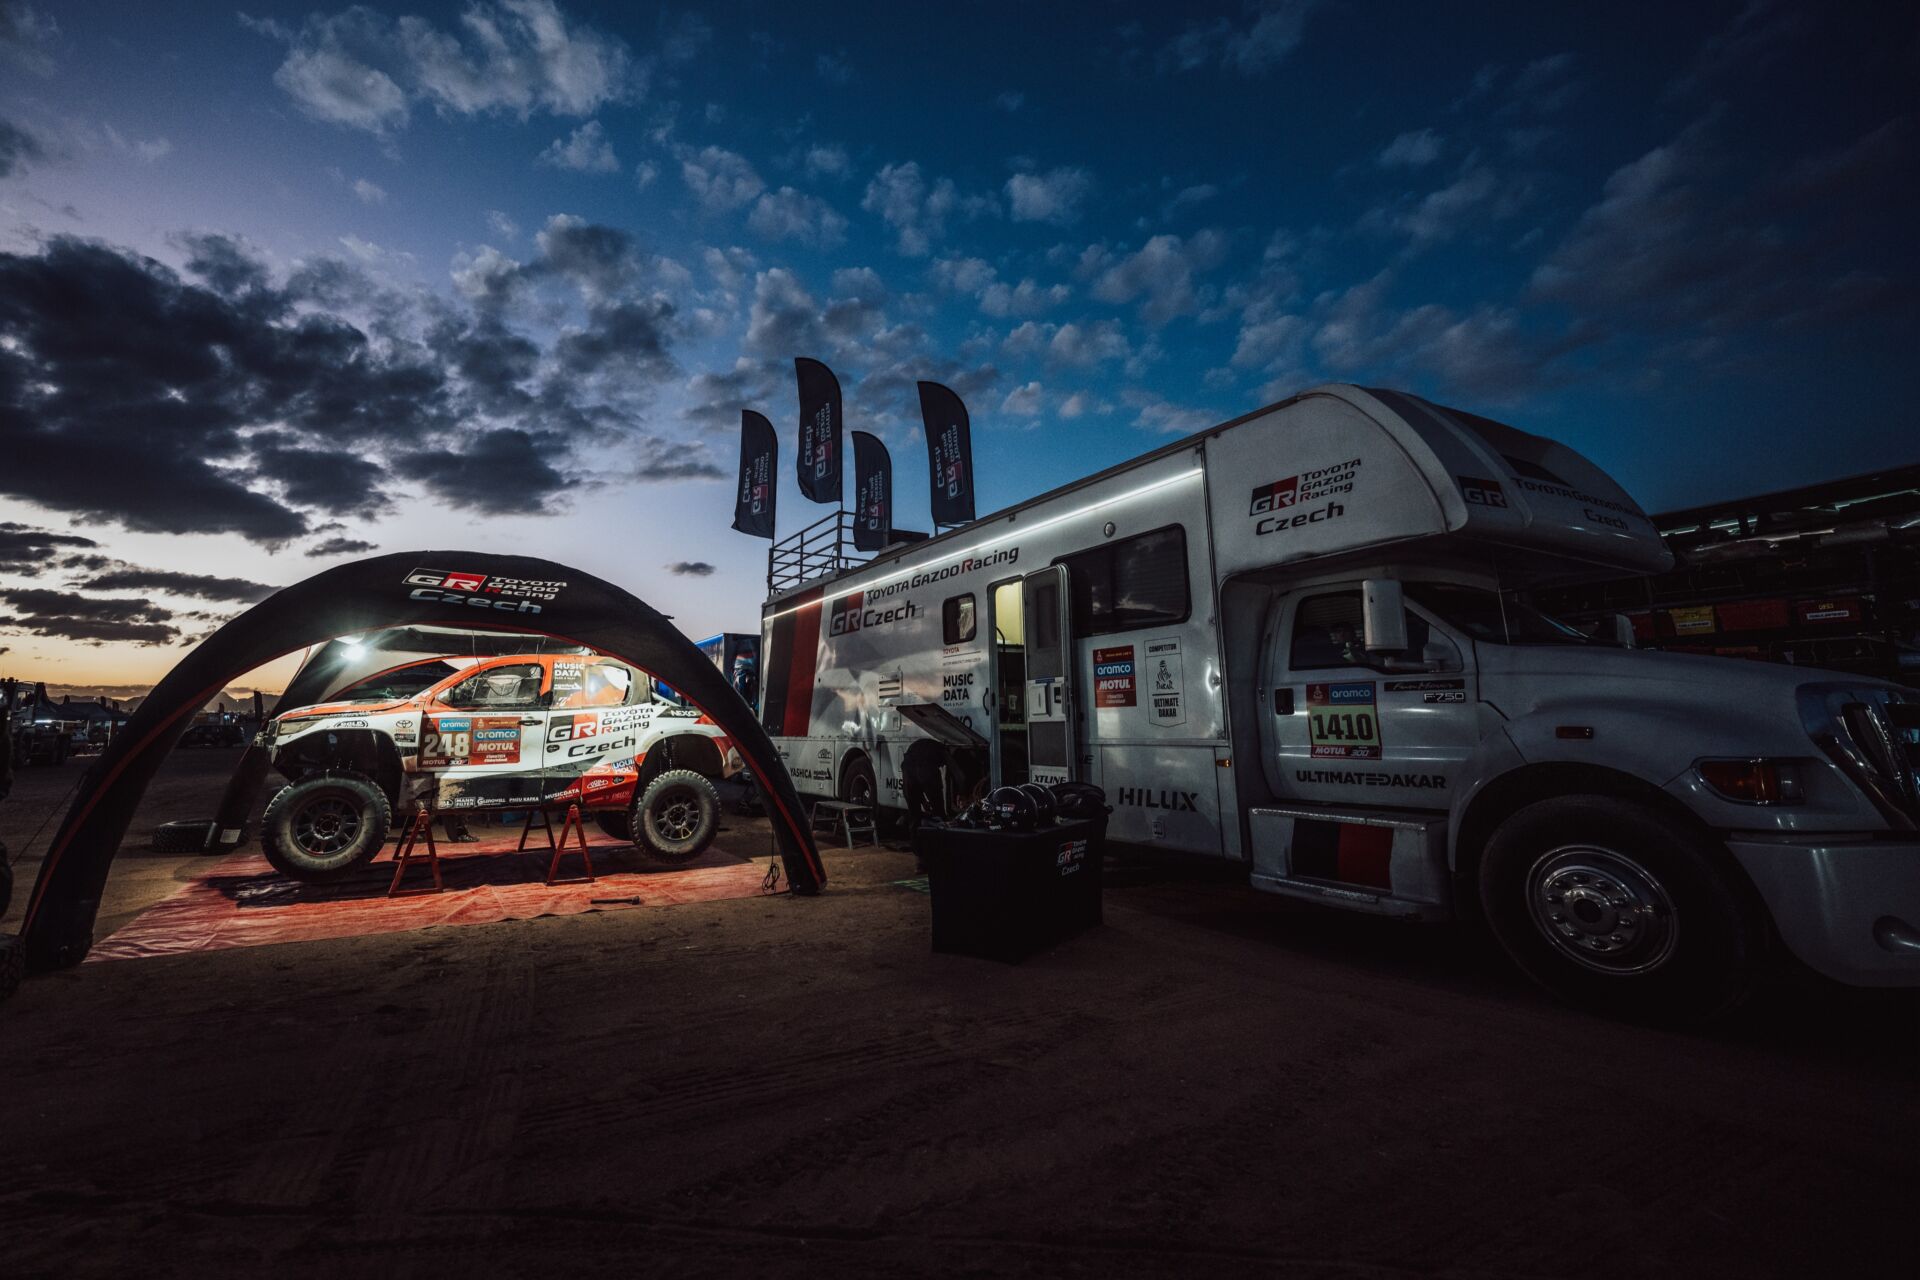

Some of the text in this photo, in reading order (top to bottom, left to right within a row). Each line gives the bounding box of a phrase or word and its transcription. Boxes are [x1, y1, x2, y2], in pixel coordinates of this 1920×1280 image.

[1301, 458, 1362, 482] TOYOTA
[1300, 471, 1356, 492] GAZOO
[1299, 482, 1354, 503] Racing
[1251, 489, 1295, 515] GR
[1256, 502, 1345, 536] Czech
[1583, 509, 1629, 531] Czech
[866, 547, 1020, 602] TOYOTA GAZOO Racing
[408, 574, 479, 592] GR
[487, 582, 560, 593] GAZOO
[491, 576, 568, 588] TOYOTA
[409, 588, 543, 614] Czech
[863, 600, 916, 627] Czech
[831, 607, 862, 636] GR
[1148, 643, 1177, 653] COMPETITOR
[1097, 664, 1131, 676] aramco
[943, 673, 974, 688] MUSIC
[1099, 678, 1131, 690] MOTUL
[943, 688, 970, 701] DATA
[1331, 689, 1371, 698] aramco
[1153, 697, 1179, 708] ULTIMATE
[603, 707, 654, 718] TOYOTA
[1158, 707, 1177, 718] DAKAR
[601, 714, 650, 726] GAZOO
[1312, 713, 1374, 741] 1410
[476, 731, 517, 739] aramco
[550, 721, 597, 741] GR
[601, 721, 650, 735] Racing
[423, 733, 470, 758] 248
[477, 742, 515, 752] MOTUL
[567, 736, 636, 758] Czech
[1314, 747, 1346, 755] MOTUL
[790, 768, 812, 778] YASHICA
[886, 778, 904, 790] MUS
[1118, 787, 1199, 812] HILUX
